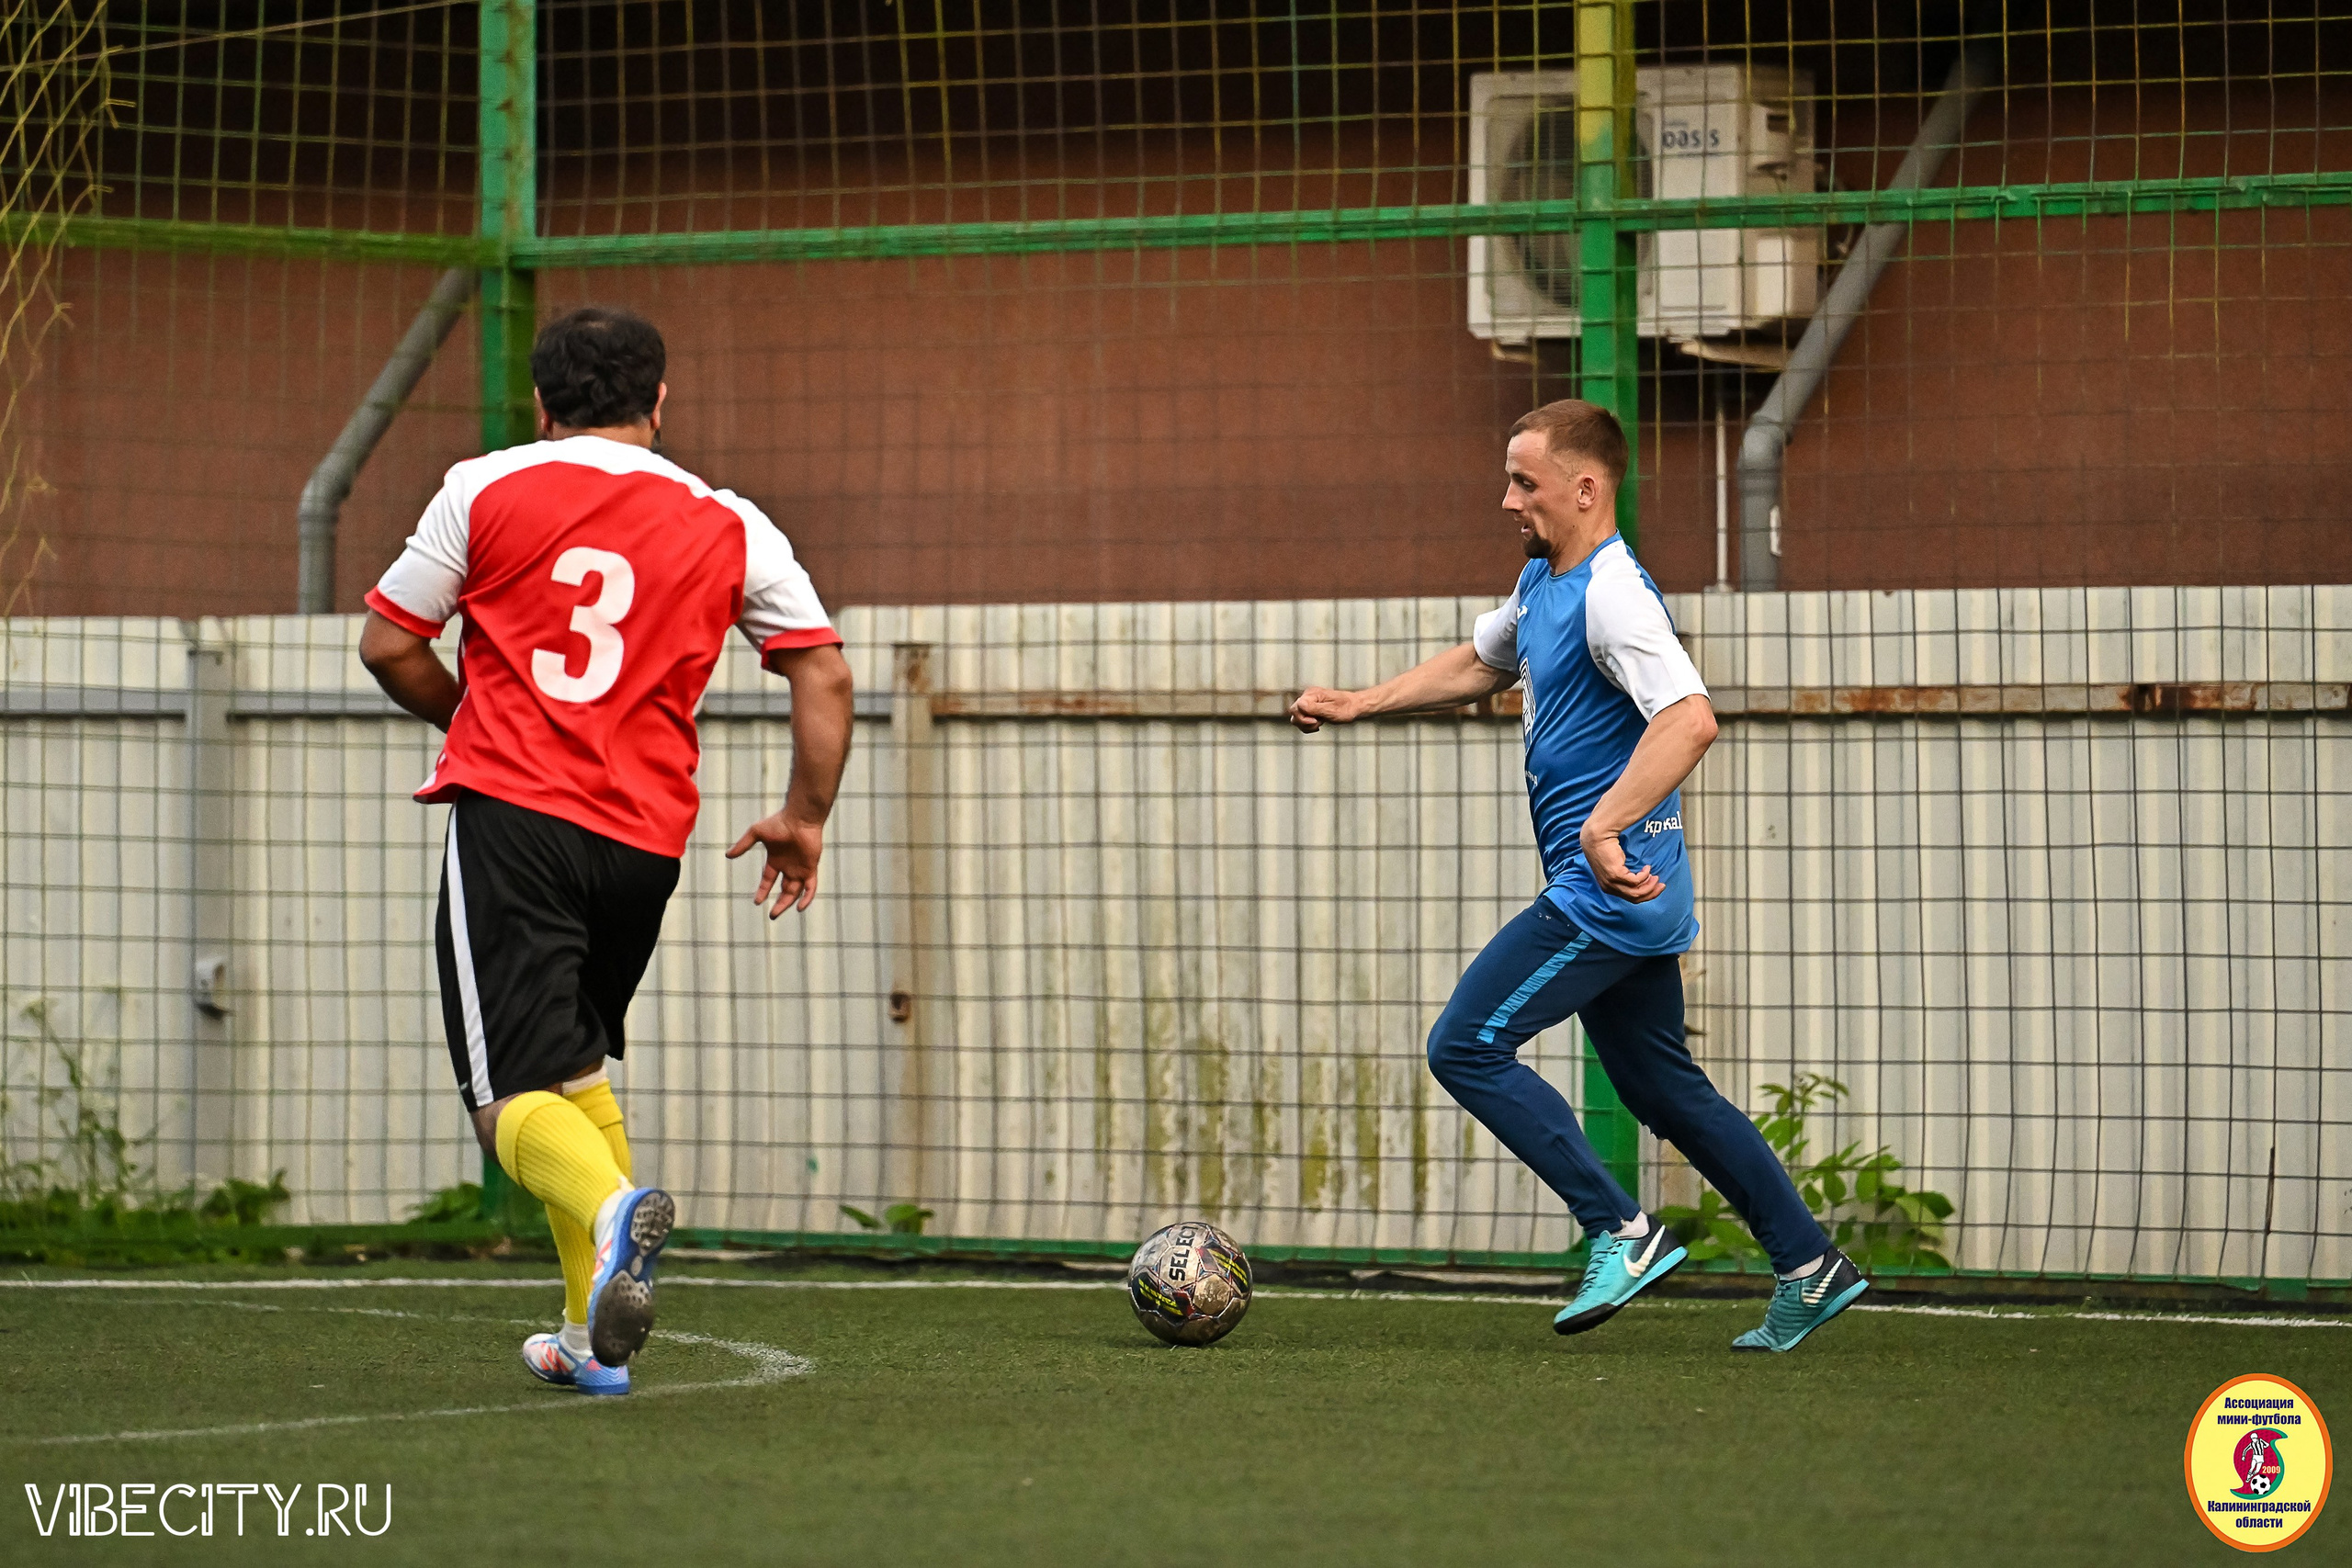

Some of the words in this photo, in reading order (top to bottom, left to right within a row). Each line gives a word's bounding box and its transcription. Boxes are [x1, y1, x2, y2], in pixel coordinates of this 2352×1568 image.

[1662, 129, 1719, 148] oass
[531, 547, 635, 704] 3
[1169, 1225, 1198, 1281] SELECT
